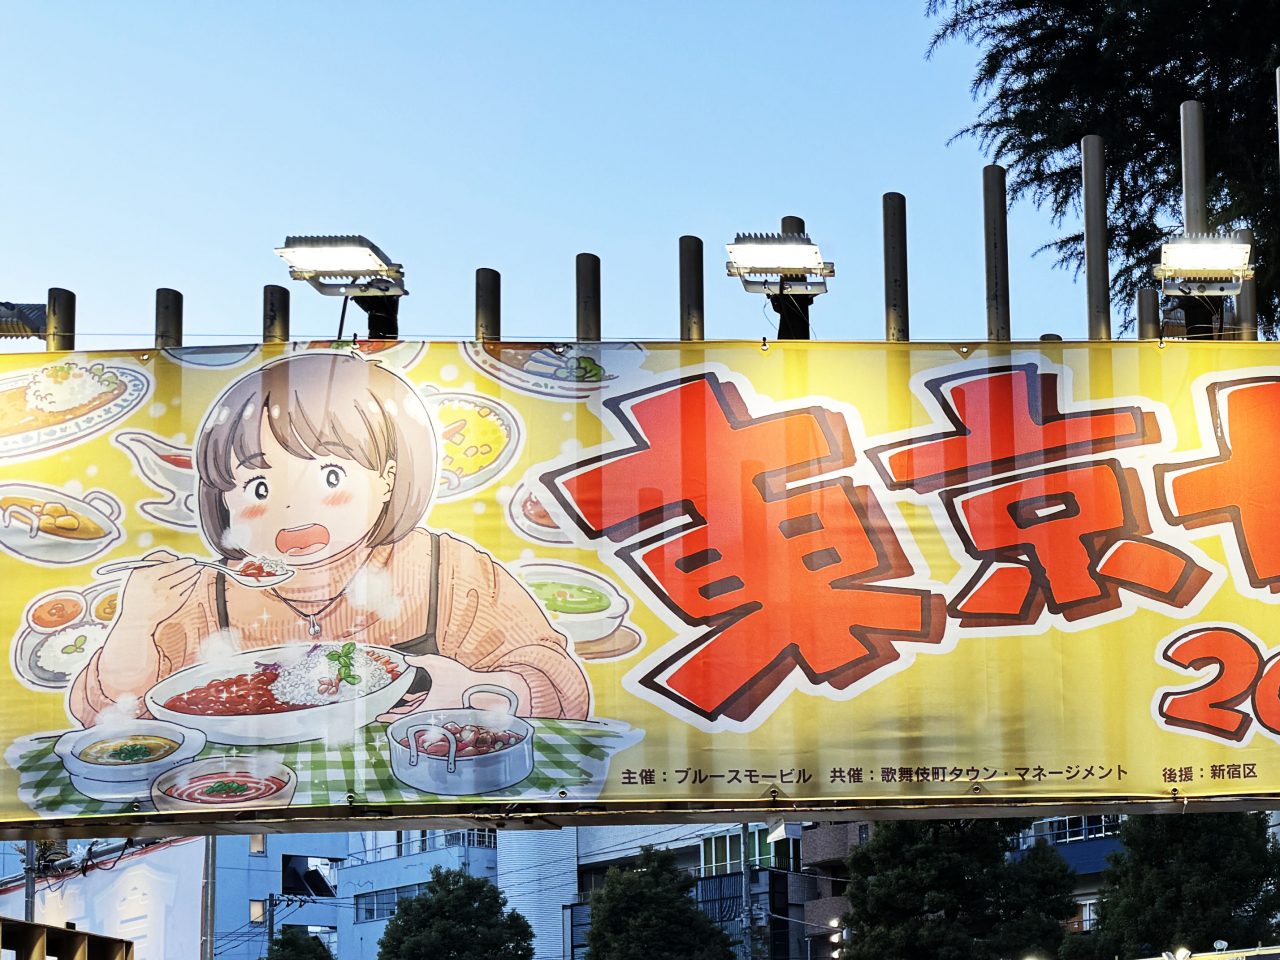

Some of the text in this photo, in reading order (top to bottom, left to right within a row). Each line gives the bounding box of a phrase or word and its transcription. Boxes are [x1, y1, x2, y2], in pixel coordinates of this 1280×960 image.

[621, 767, 812, 786] 主催：ブルースモービル
[1162, 762, 1258, 784] 後援：新宿区
